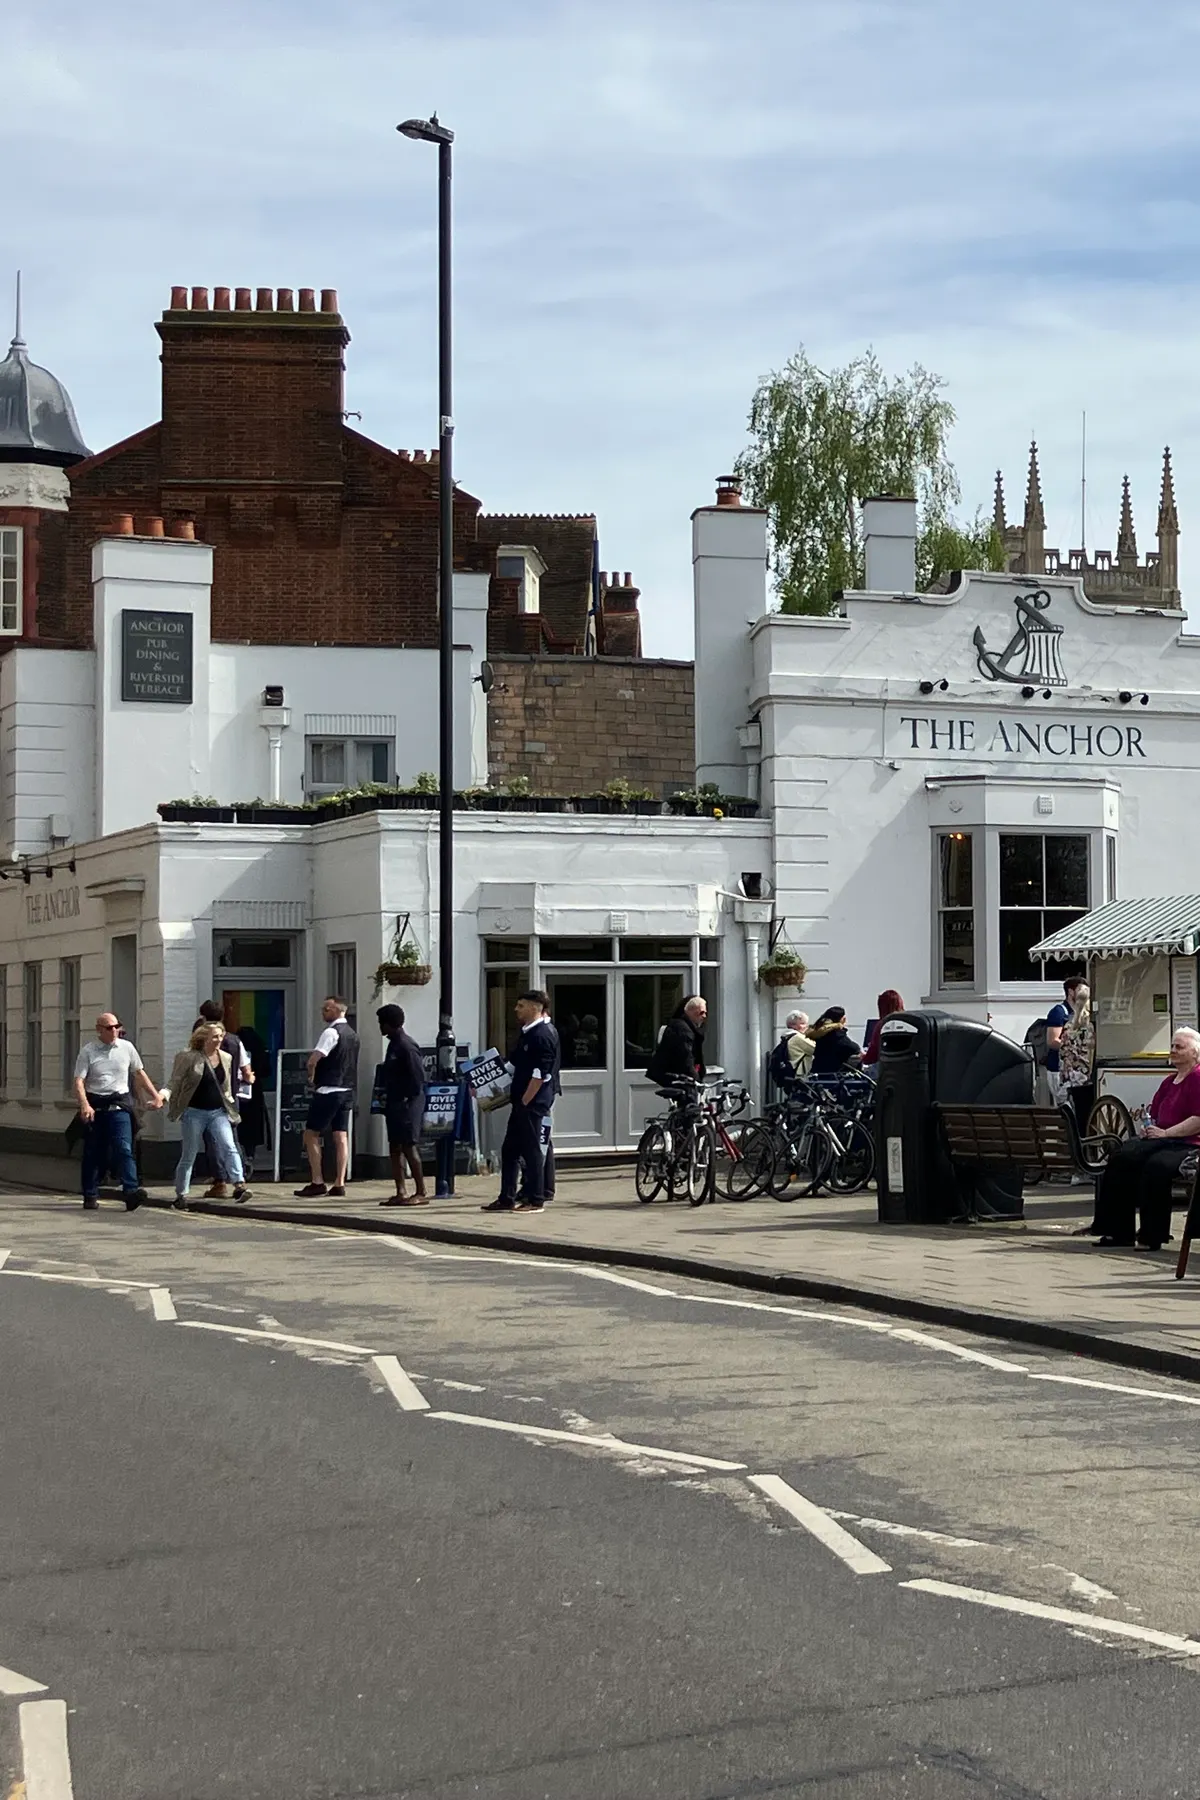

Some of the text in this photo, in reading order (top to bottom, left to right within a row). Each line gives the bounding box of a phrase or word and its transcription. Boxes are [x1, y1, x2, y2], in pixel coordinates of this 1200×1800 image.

[130, 621, 185, 634] ANCHOR
[147, 638, 168, 649] PUB
[136, 650, 180, 661] DINING
[133, 683, 183, 695] TERRACE
[900, 717, 1147, 758] THE ANCHOR
[26, 886, 81, 924] THE ANCHOR
[470, 1060, 497, 1079] RIVER
[471, 1067, 503, 1087] TOURS
[428, 1103, 456, 1111] TOURS
